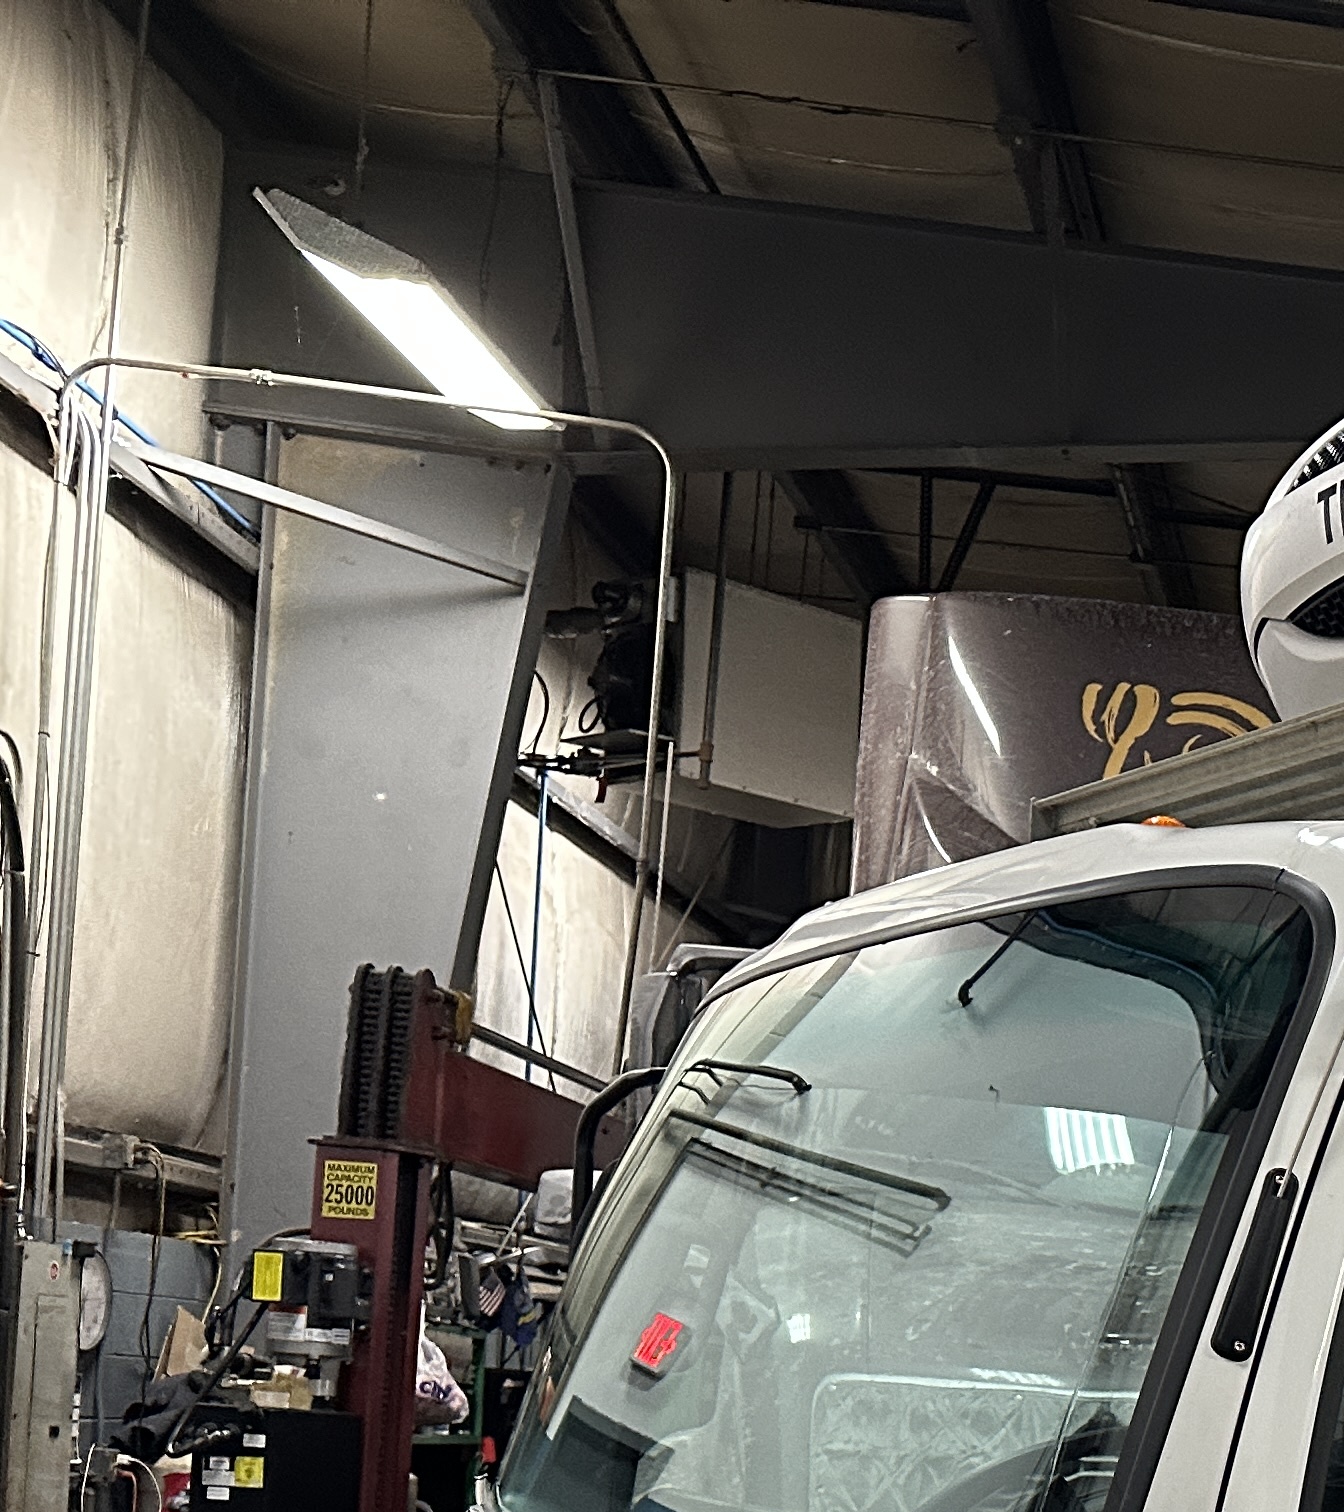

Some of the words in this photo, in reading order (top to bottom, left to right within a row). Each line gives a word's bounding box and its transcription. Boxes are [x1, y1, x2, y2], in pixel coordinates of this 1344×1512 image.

[327, 1163, 376, 1174] MAXIMUM
[326, 1172, 375, 1184] CAPACITY
[324, 1183, 375, 1207] 25000
[327, 1205, 370, 1217] POUNDS
